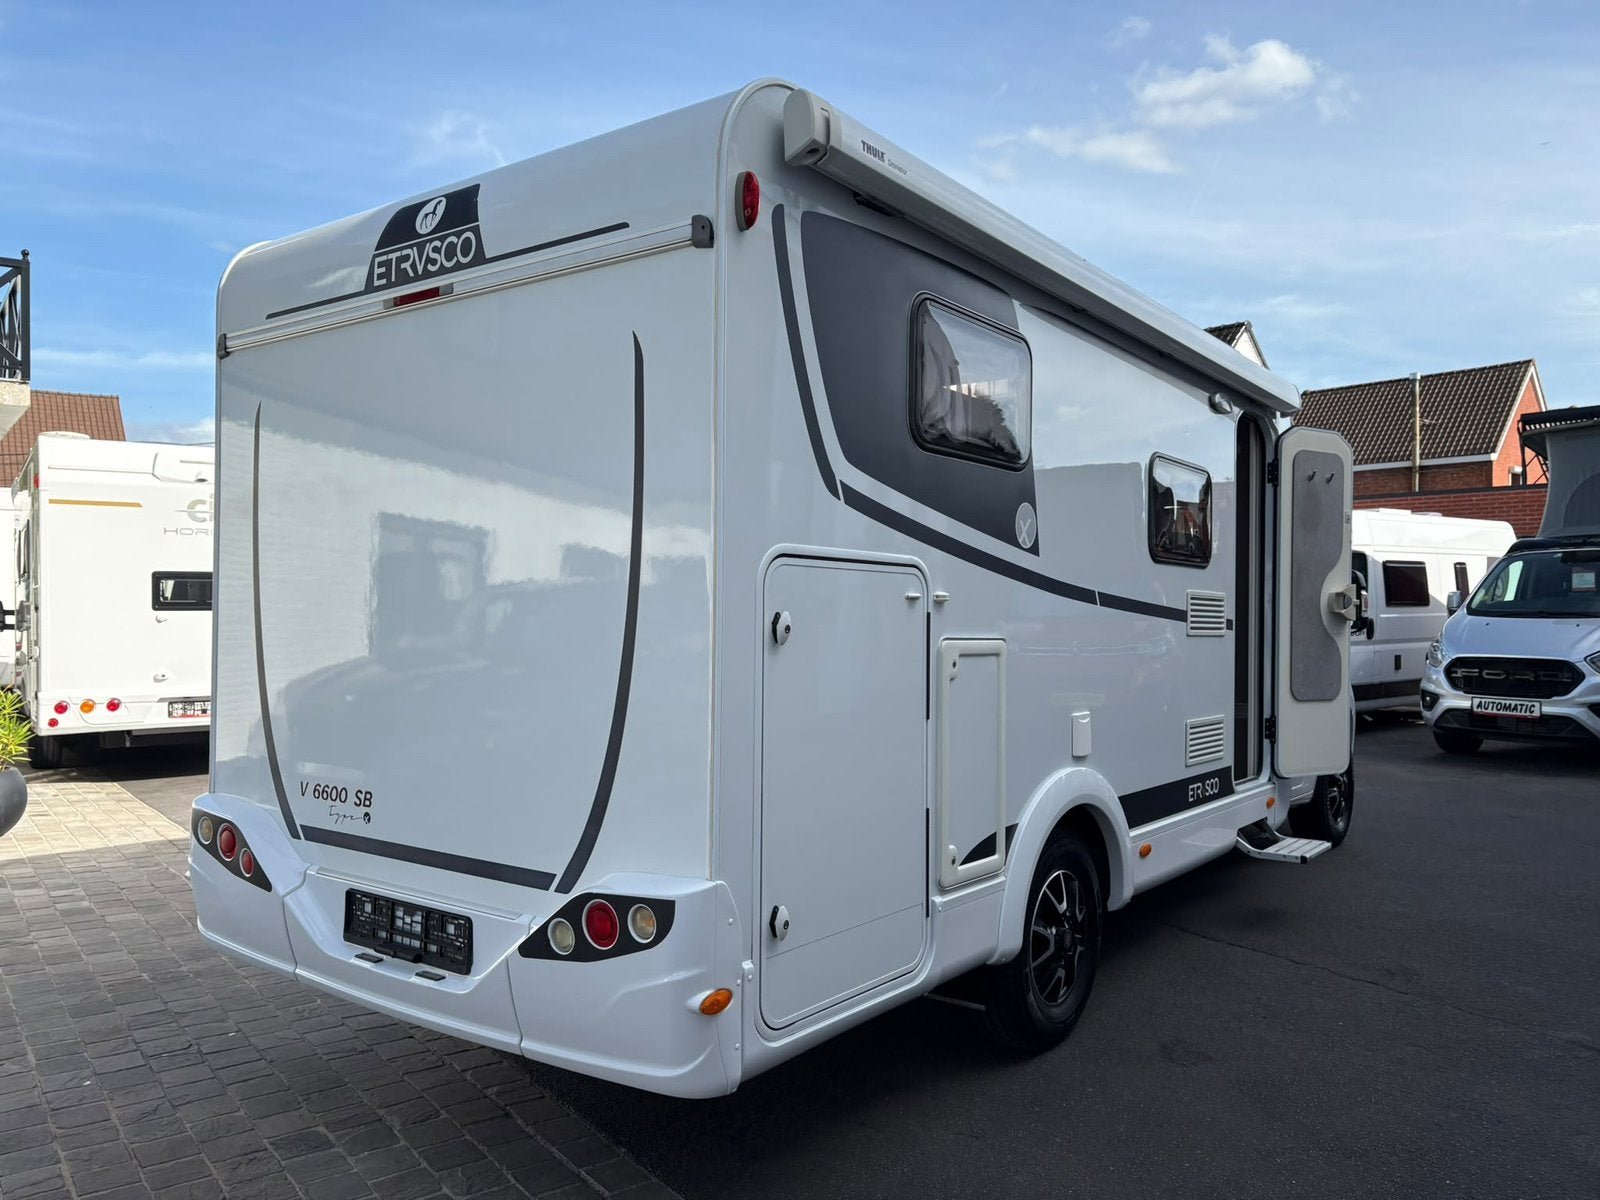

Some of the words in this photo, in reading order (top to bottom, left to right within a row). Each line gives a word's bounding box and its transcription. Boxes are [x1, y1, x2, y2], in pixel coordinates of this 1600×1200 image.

[861, 139, 886, 163] THULE
[163, 527, 213, 536] HOR
[1453, 668, 1567, 682] FORD
[1476, 700, 1536, 714] AUTOMATIC
[300, 781, 309, 797] V
[313, 783, 348, 804] 6600
[354, 789, 373, 808] SB
